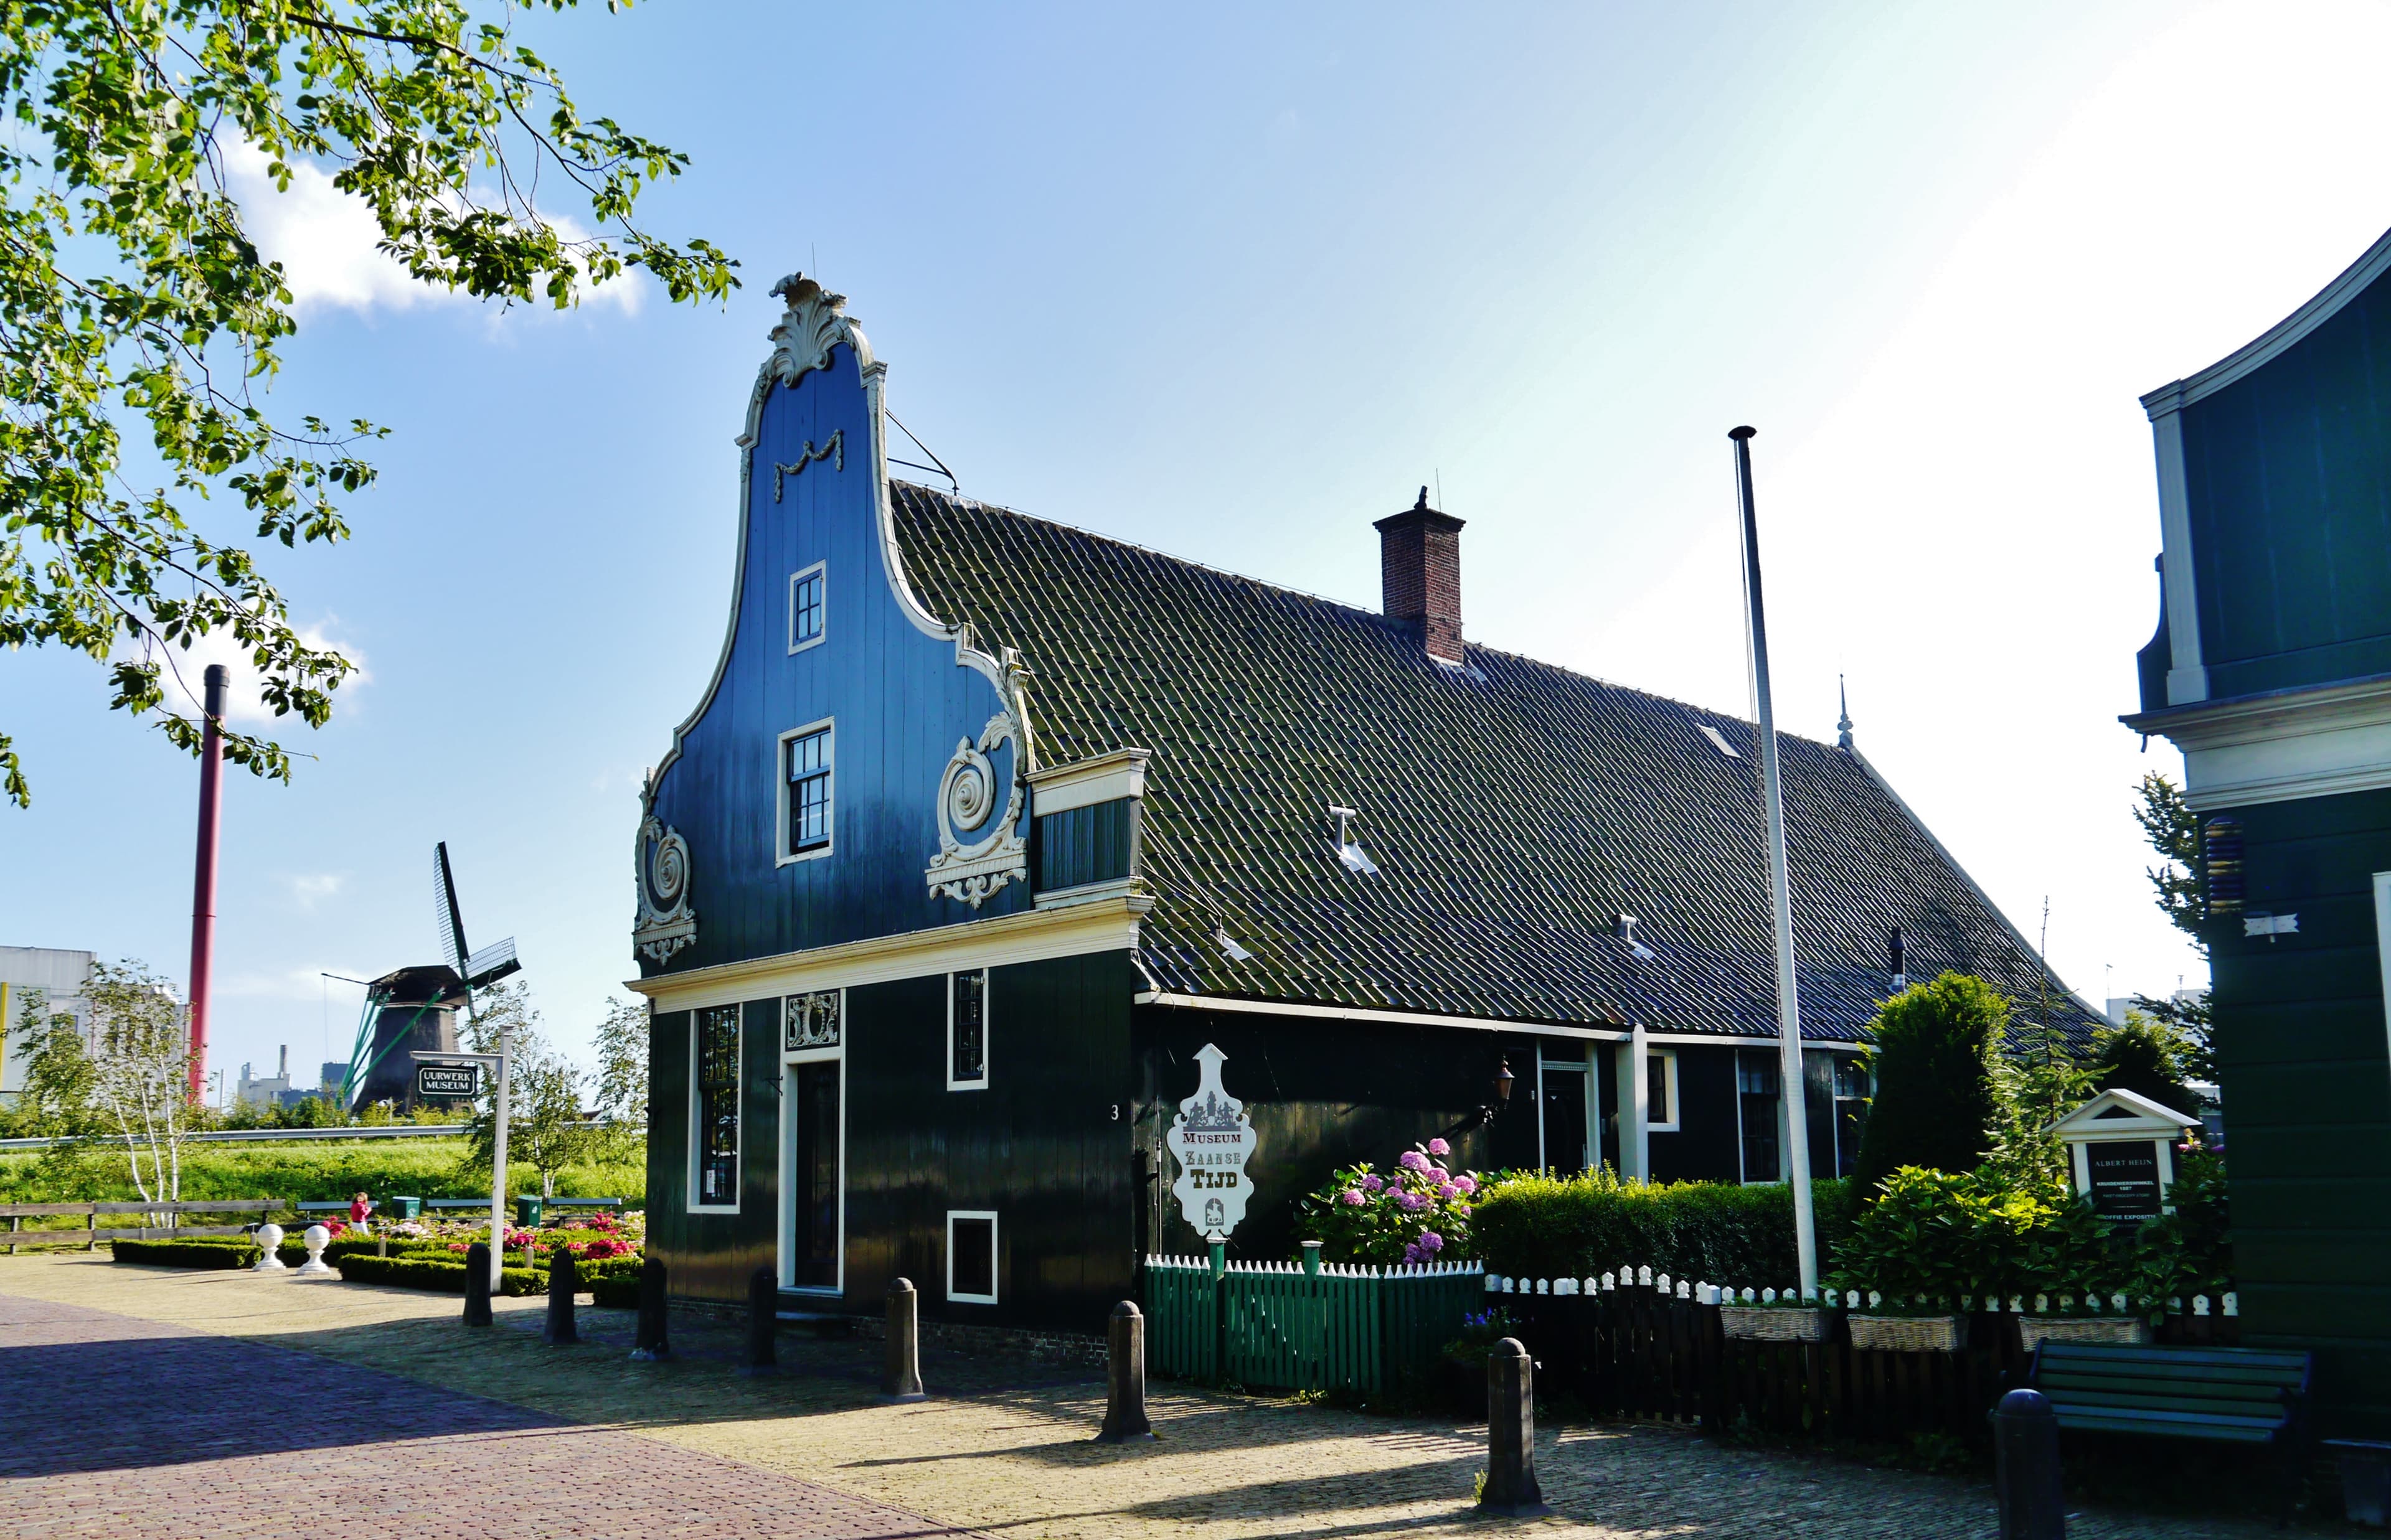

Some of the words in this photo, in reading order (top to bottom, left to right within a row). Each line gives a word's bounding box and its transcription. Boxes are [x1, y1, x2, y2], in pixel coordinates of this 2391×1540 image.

[423, 1071, 471, 1081] UURWERK
[426, 1081, 468, 1090] MUSEUM
[1111, 1104, 1119, 1120] 3
[1182, 1132, 1241, 1144] MUSEUM
[1185, 1150, 1241, 1165] ZAANSE
[1190, 1168, 1237, 1189] TIJD
